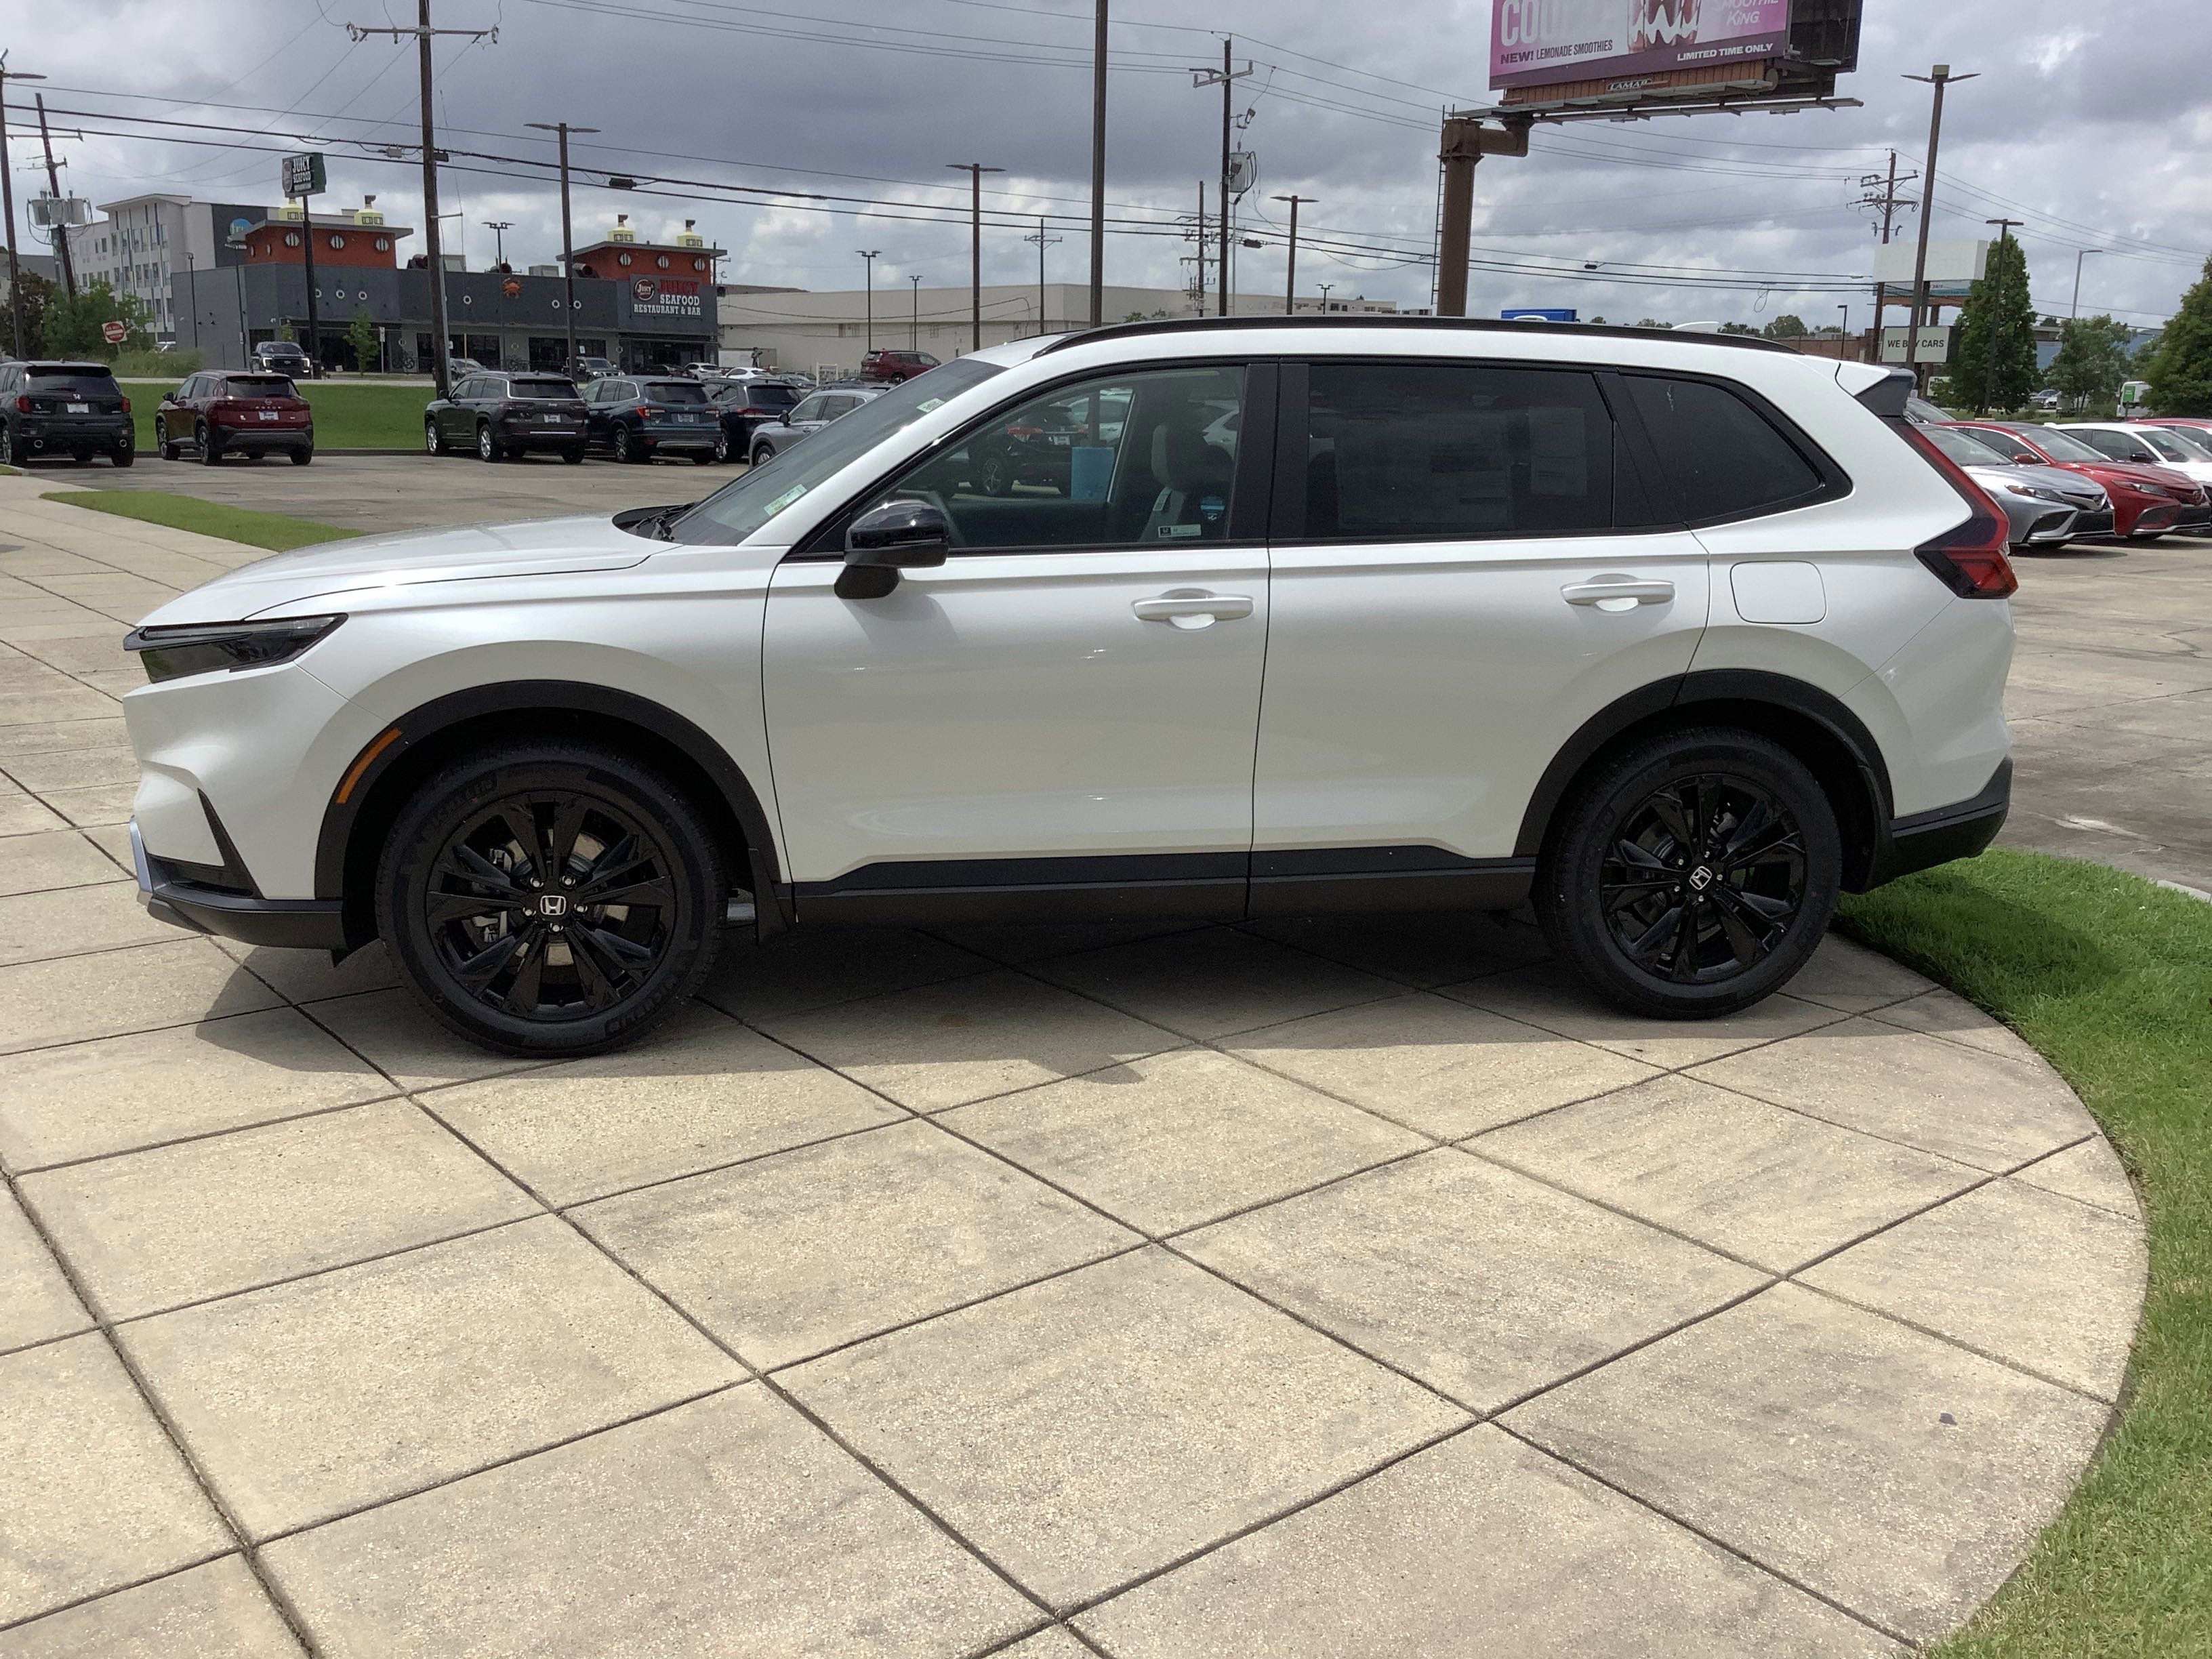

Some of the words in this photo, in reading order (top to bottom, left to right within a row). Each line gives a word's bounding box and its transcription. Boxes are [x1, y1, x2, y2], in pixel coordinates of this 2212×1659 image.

[1500, 50, 1534, 64] NEW!
[1536, 45, 1572, 60] LEMONADE
[1574, 39, 1613, 55] SMOOTHIES
[1677, 49, 1717, 61] LIMITED
[1719, 46, 1744, 56] TIME
[1745, 43, 1773, 54] ONLY
[292, 155, 310, 173] JUICY
[660, 294, 699, 306] SEAFOOD
[634, 304, 679, 314] RESTAURANT
[681, 306, 686, 314] &
[687, 307, 701, 315] BAR
